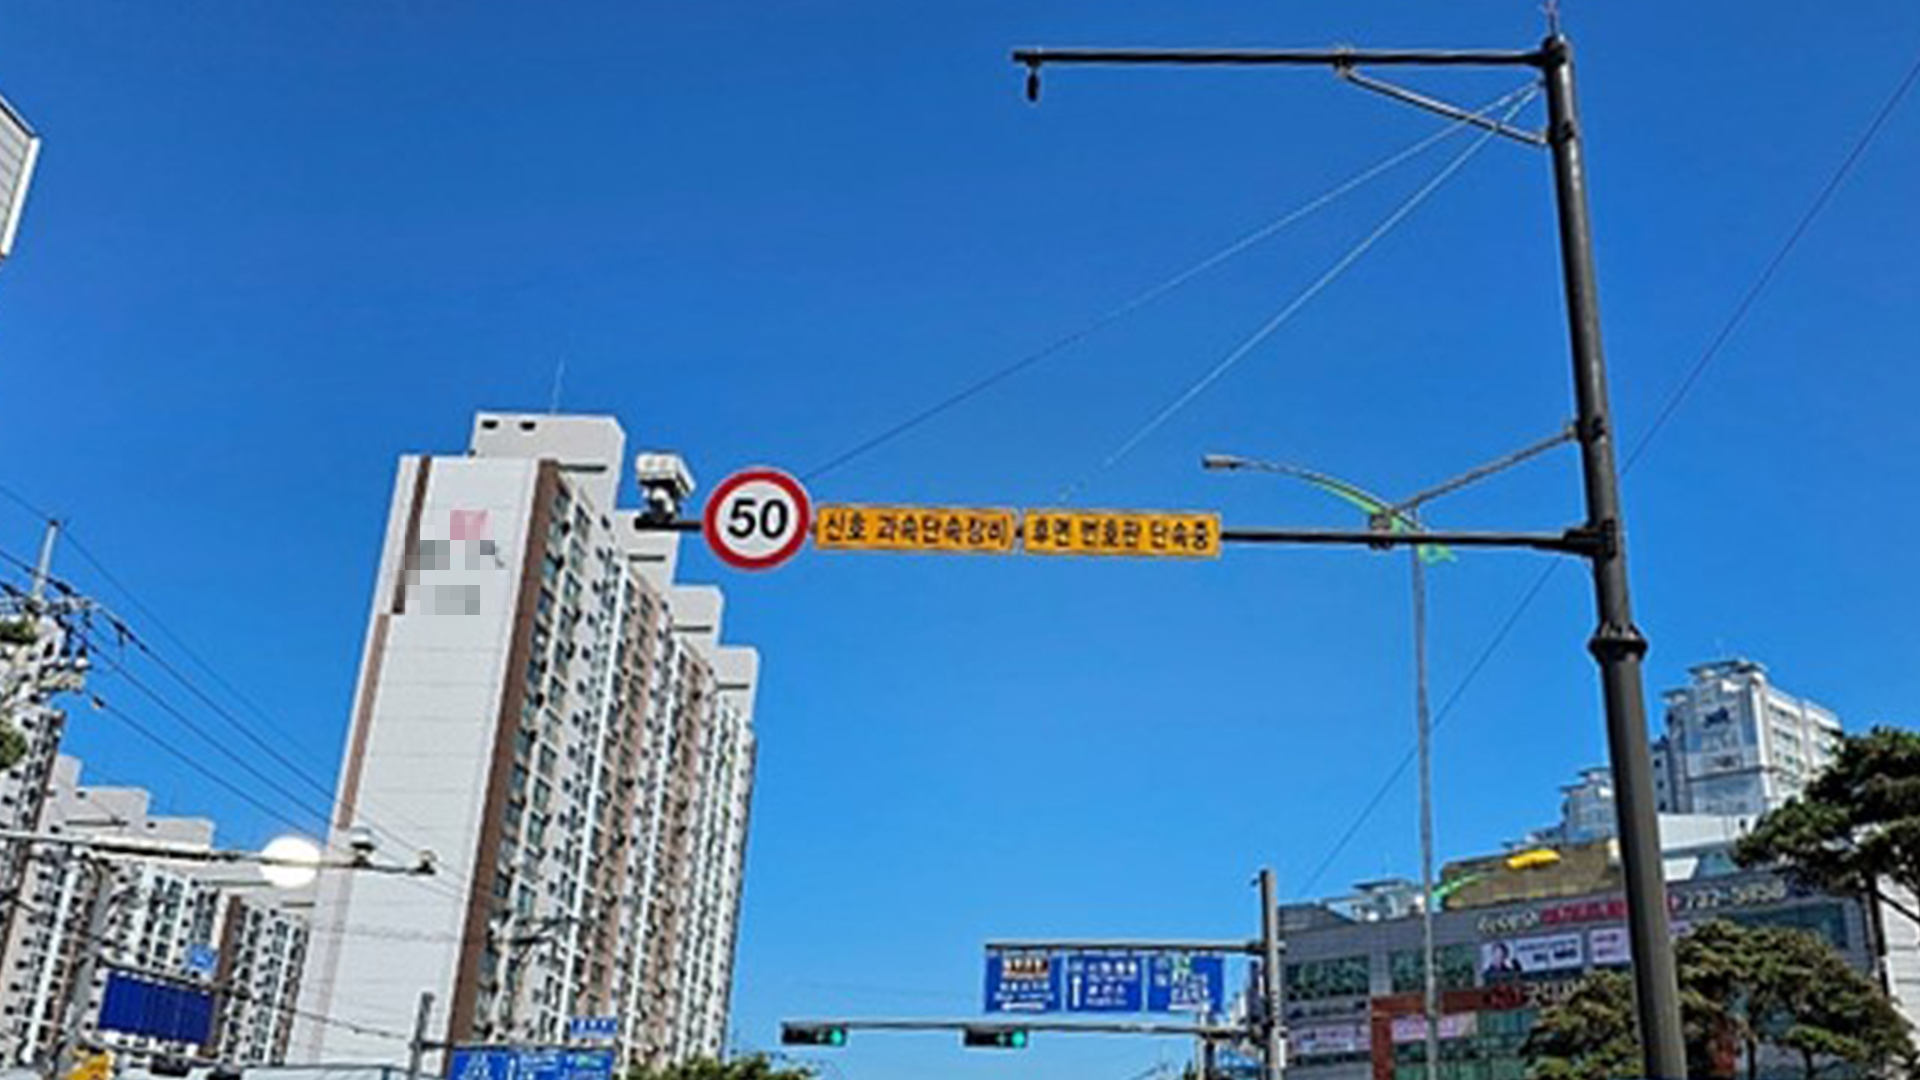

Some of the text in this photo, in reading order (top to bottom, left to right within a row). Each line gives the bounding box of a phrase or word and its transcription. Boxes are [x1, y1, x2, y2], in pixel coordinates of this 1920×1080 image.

[727, 497, 789, 540] 50
[825, 511, 1008, 547] 신호 과속단속장비
[1032, 517, 1208, 551] 후면 번호판 단속중
